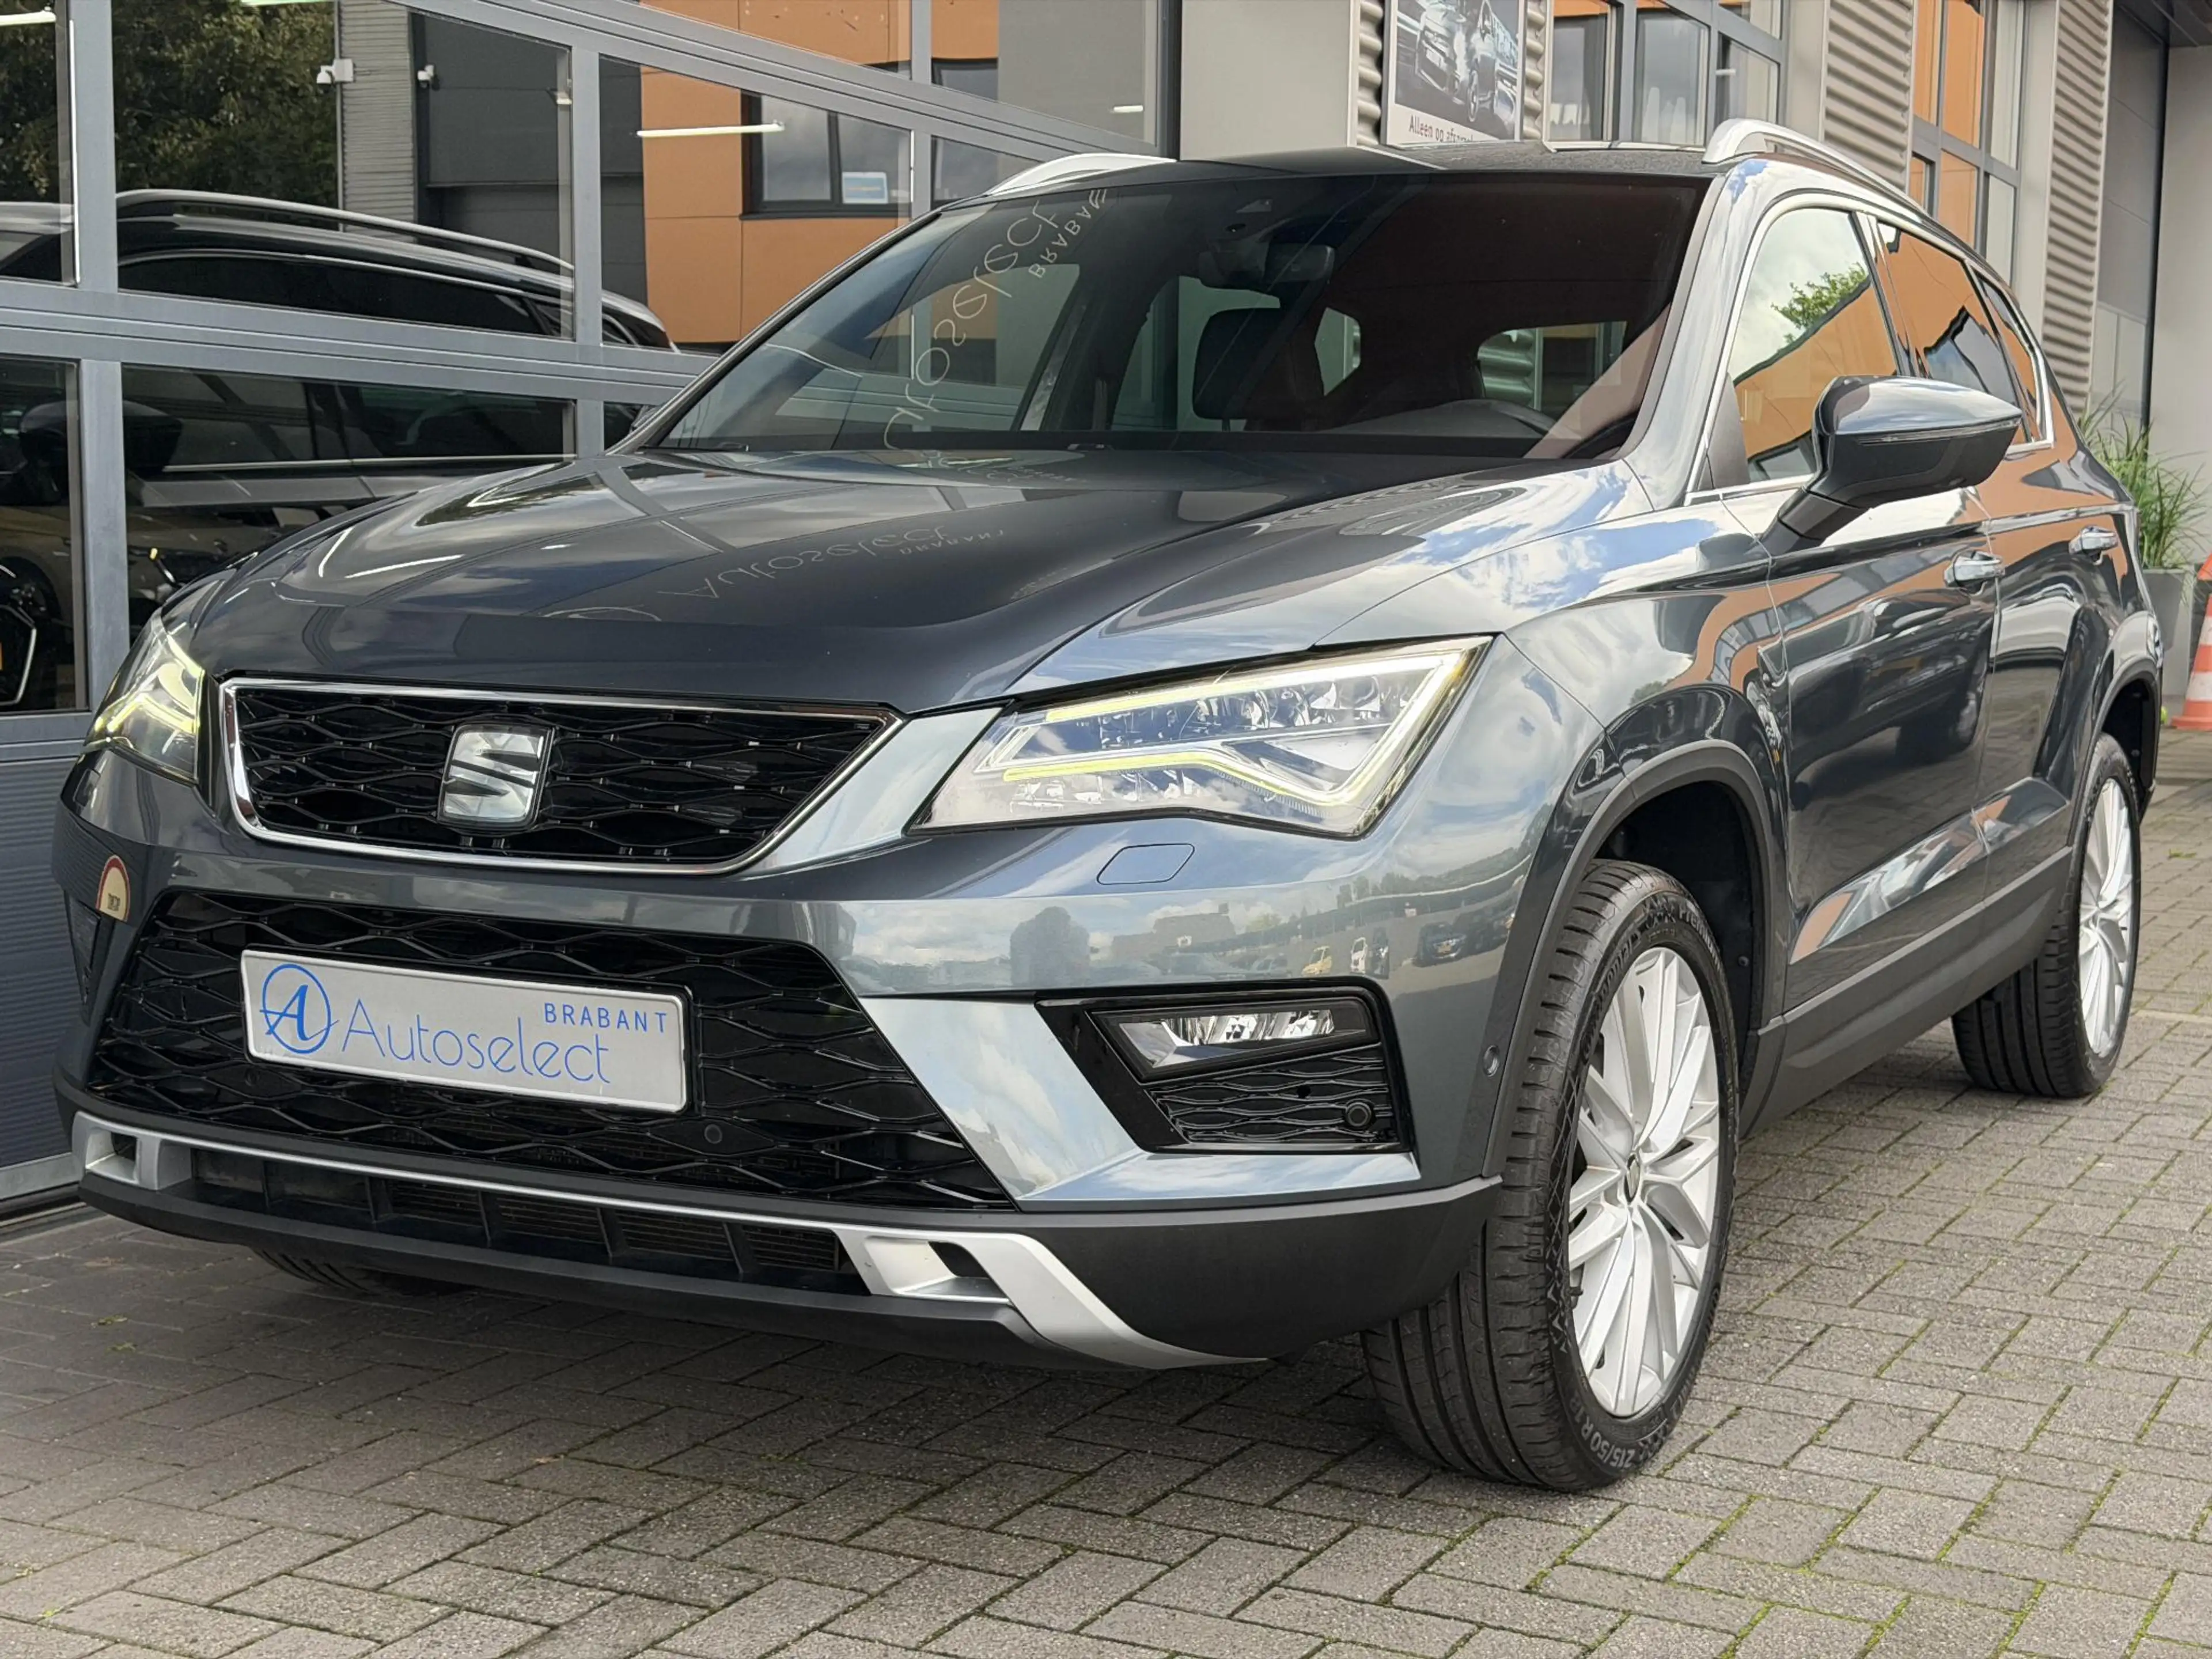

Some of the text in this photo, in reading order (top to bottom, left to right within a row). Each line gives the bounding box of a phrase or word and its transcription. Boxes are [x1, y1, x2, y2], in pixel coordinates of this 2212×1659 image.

[1408, 115, 1433, 138] Alleen
[543, 1002, 668, 1035] BRABANT
[342, 998, 611, 1084] Autoselect
[1590, 1431, 1636, 1468] 215/50
